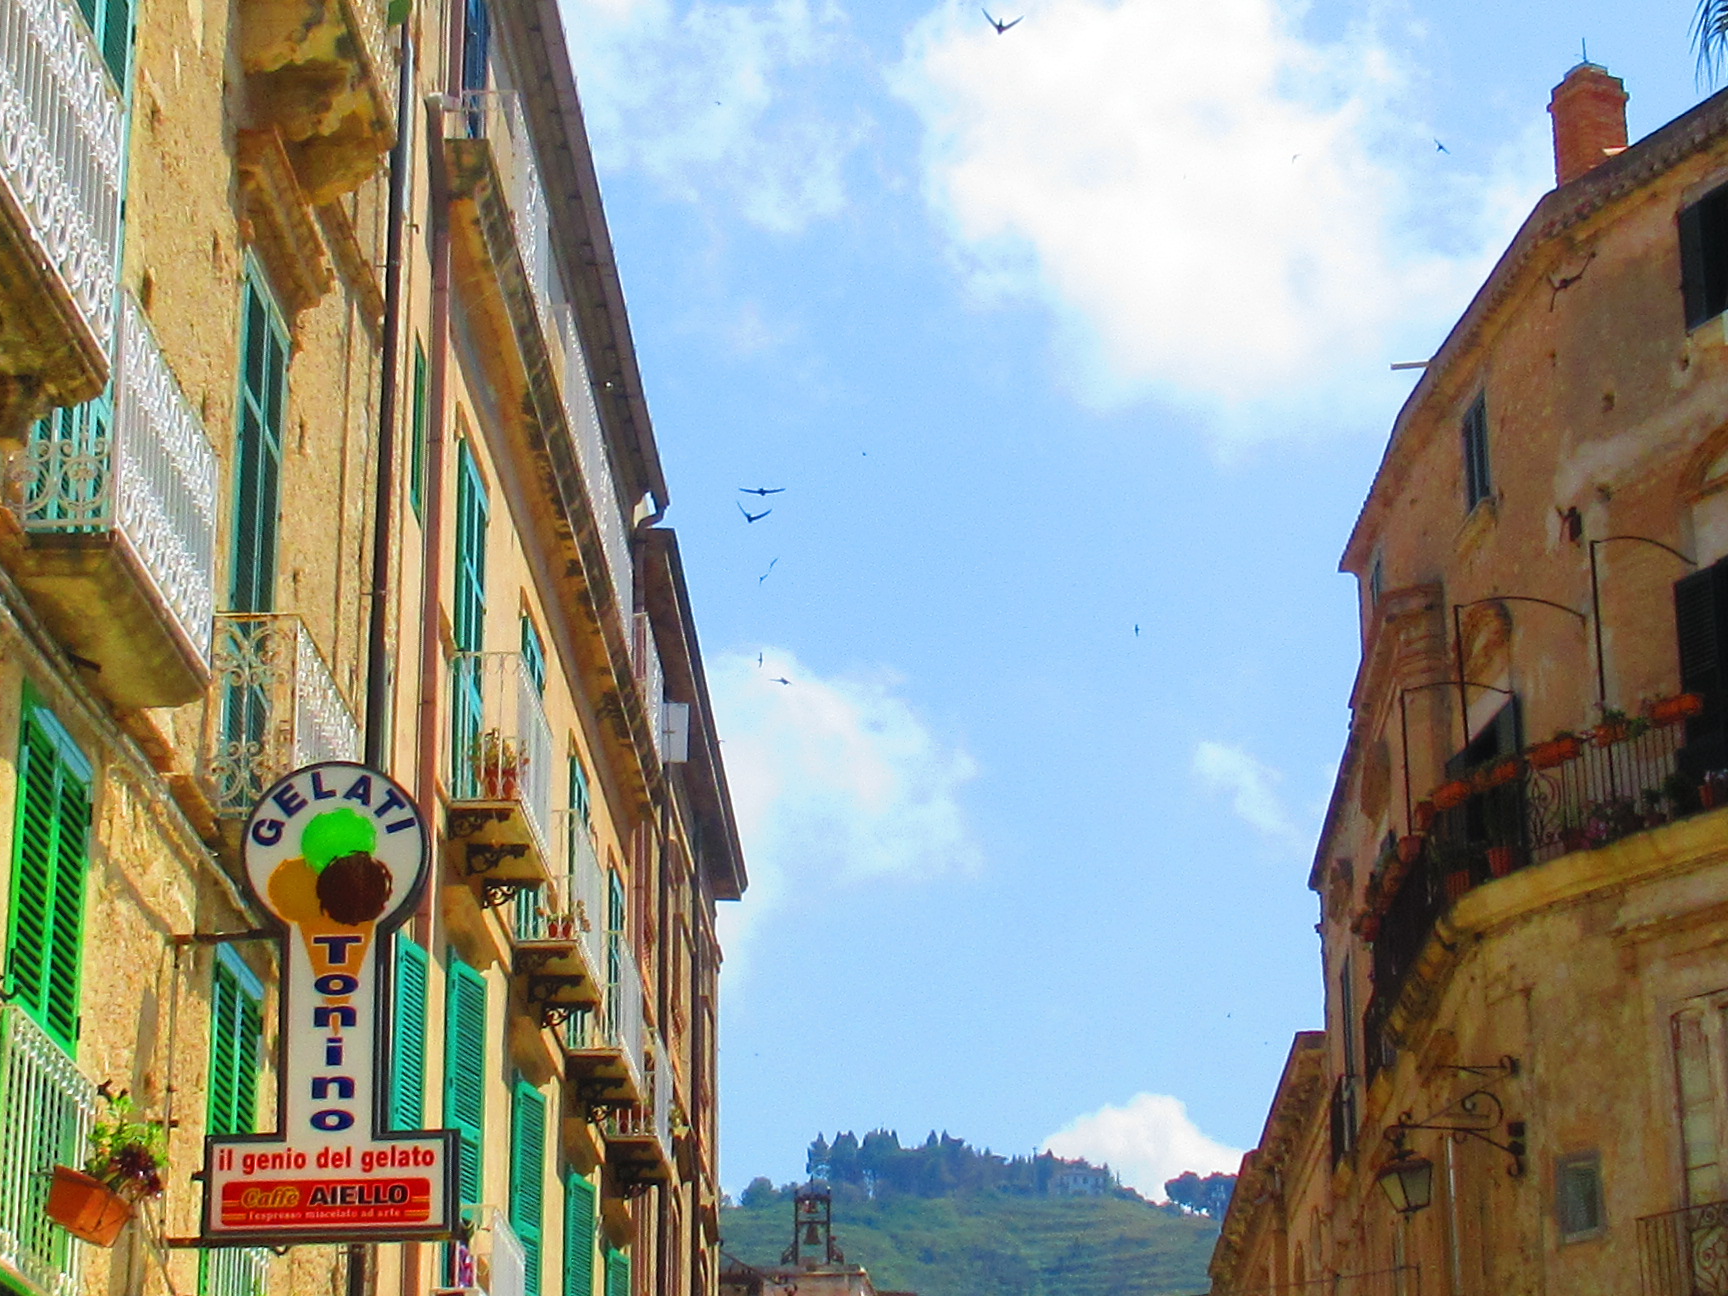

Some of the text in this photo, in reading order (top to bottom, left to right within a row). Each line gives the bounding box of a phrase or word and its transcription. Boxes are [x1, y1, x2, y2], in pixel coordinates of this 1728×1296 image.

[251, 770, 417, 848] GELATI
[309, 935, 363, 1133] Tonino
[218, 1144, 436, 1175] il genio del gelato
[307, 1183, 410, 1207] AIELLO
